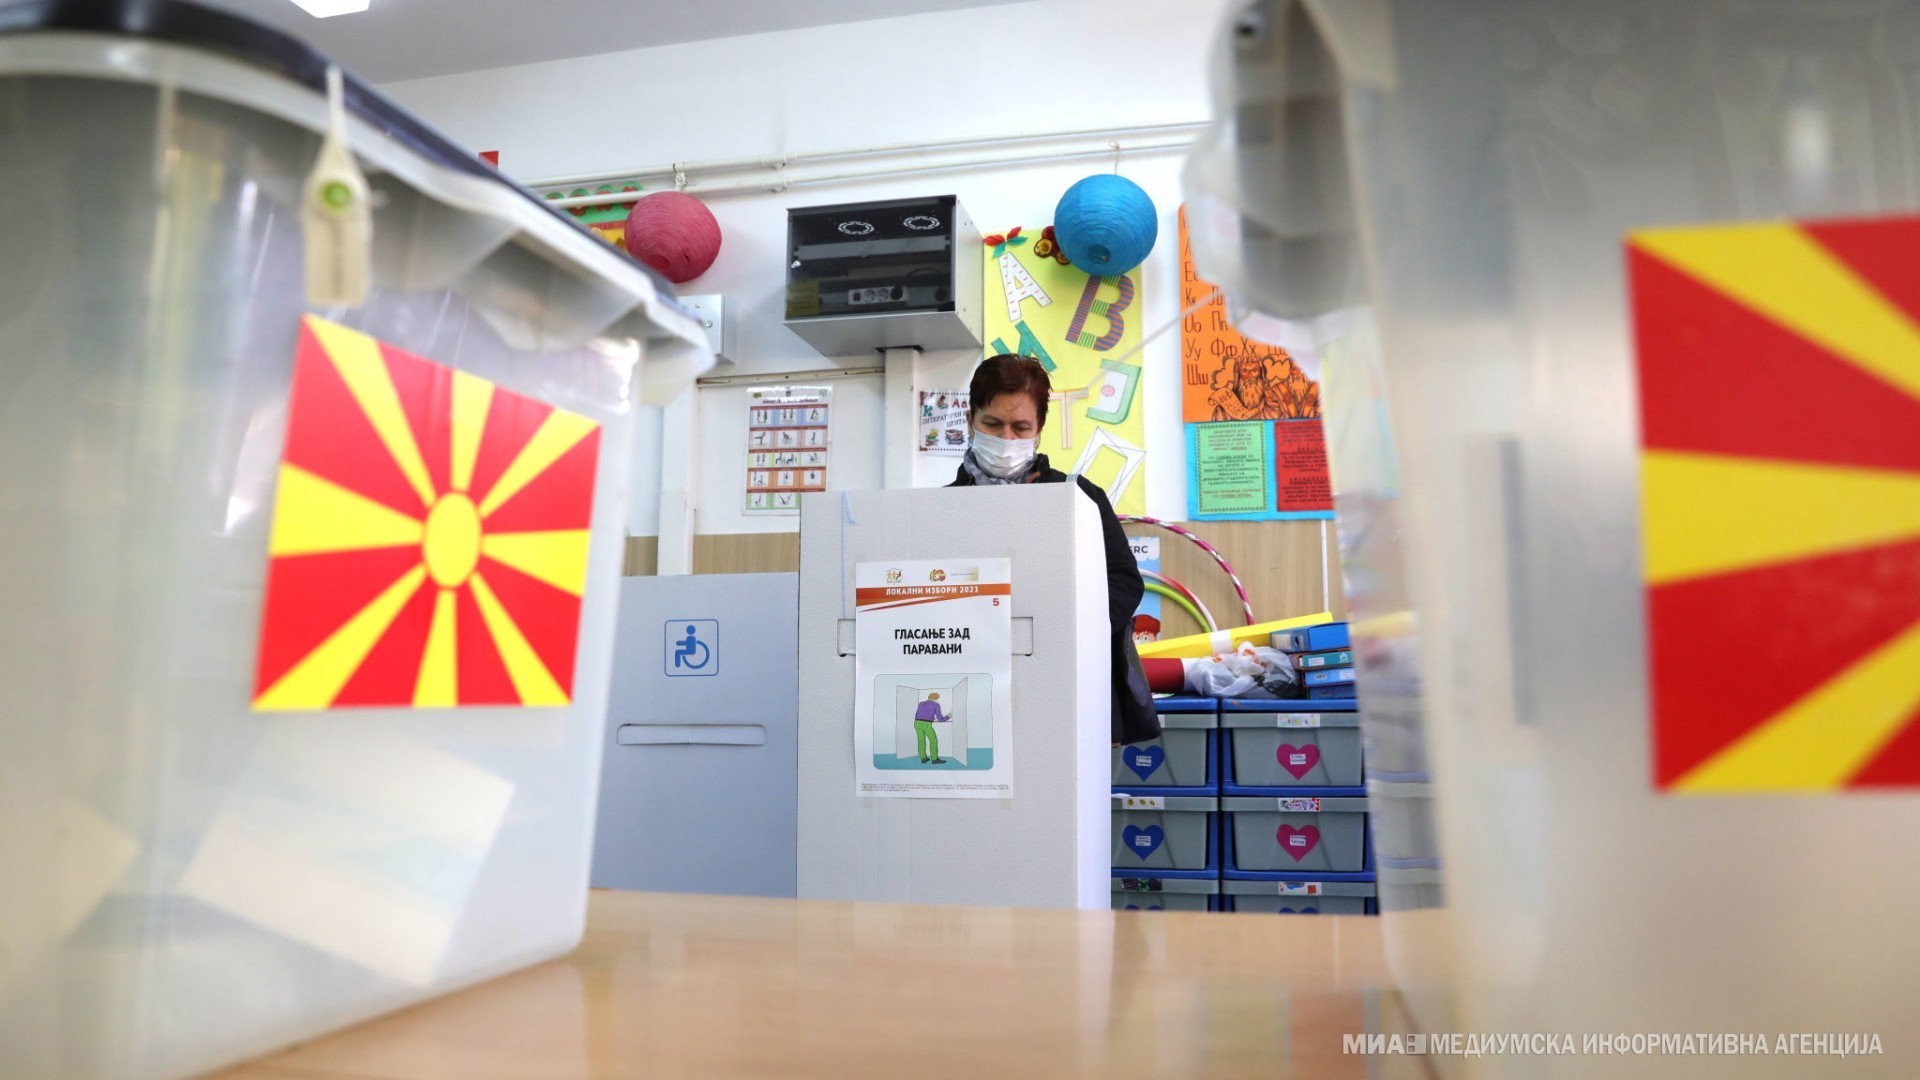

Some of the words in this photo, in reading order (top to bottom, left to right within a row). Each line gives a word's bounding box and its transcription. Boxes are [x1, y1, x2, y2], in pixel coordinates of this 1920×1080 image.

[1187, 364, 1208, 386] Шш
[885, 587, 923, 595] ЛОКАЛНИ
[925, 586, 957, 594] ИЗБОРИ
[992, 598, 1000, 607] 5
[894, 628, 946, 640] ГЛАСАЊЕ
[948, 628, 970, 640] ЗАД
[903, 643, 962, 655] ПАРАВАНИ
